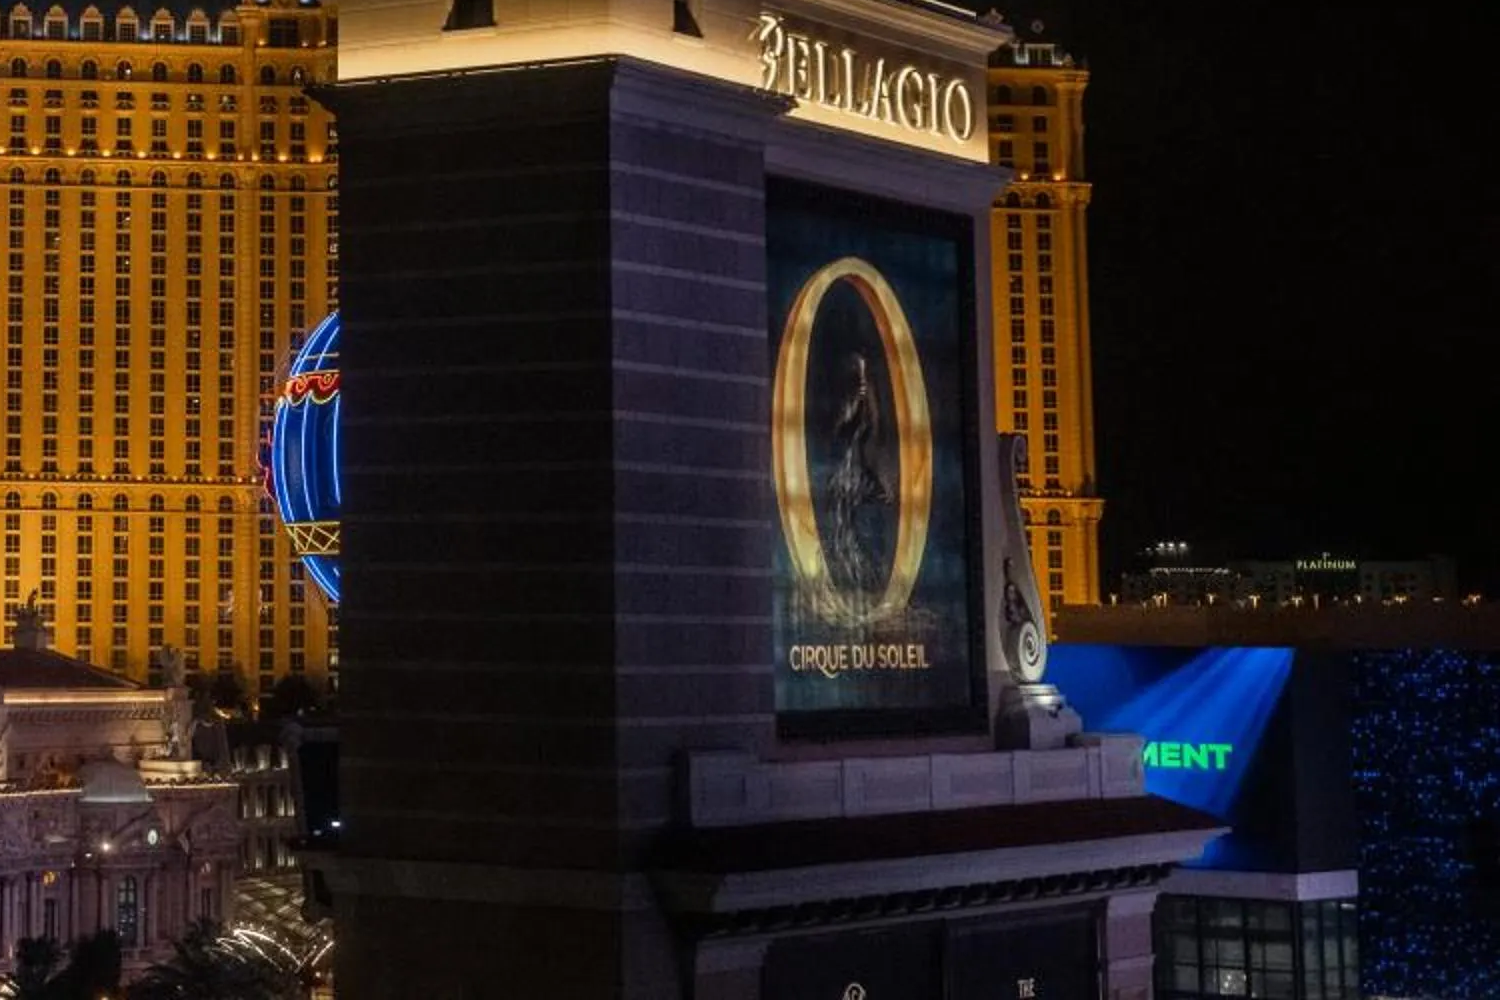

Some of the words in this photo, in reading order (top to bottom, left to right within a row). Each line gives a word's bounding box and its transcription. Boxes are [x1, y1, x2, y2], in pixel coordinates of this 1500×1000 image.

[1297, 559, 1357, 569] PLATINUM
[789, 644, 849, 679] CIRQUE
[851, 644, 875, 669] DU
[877, 644, 931, 669] SOLEIL
